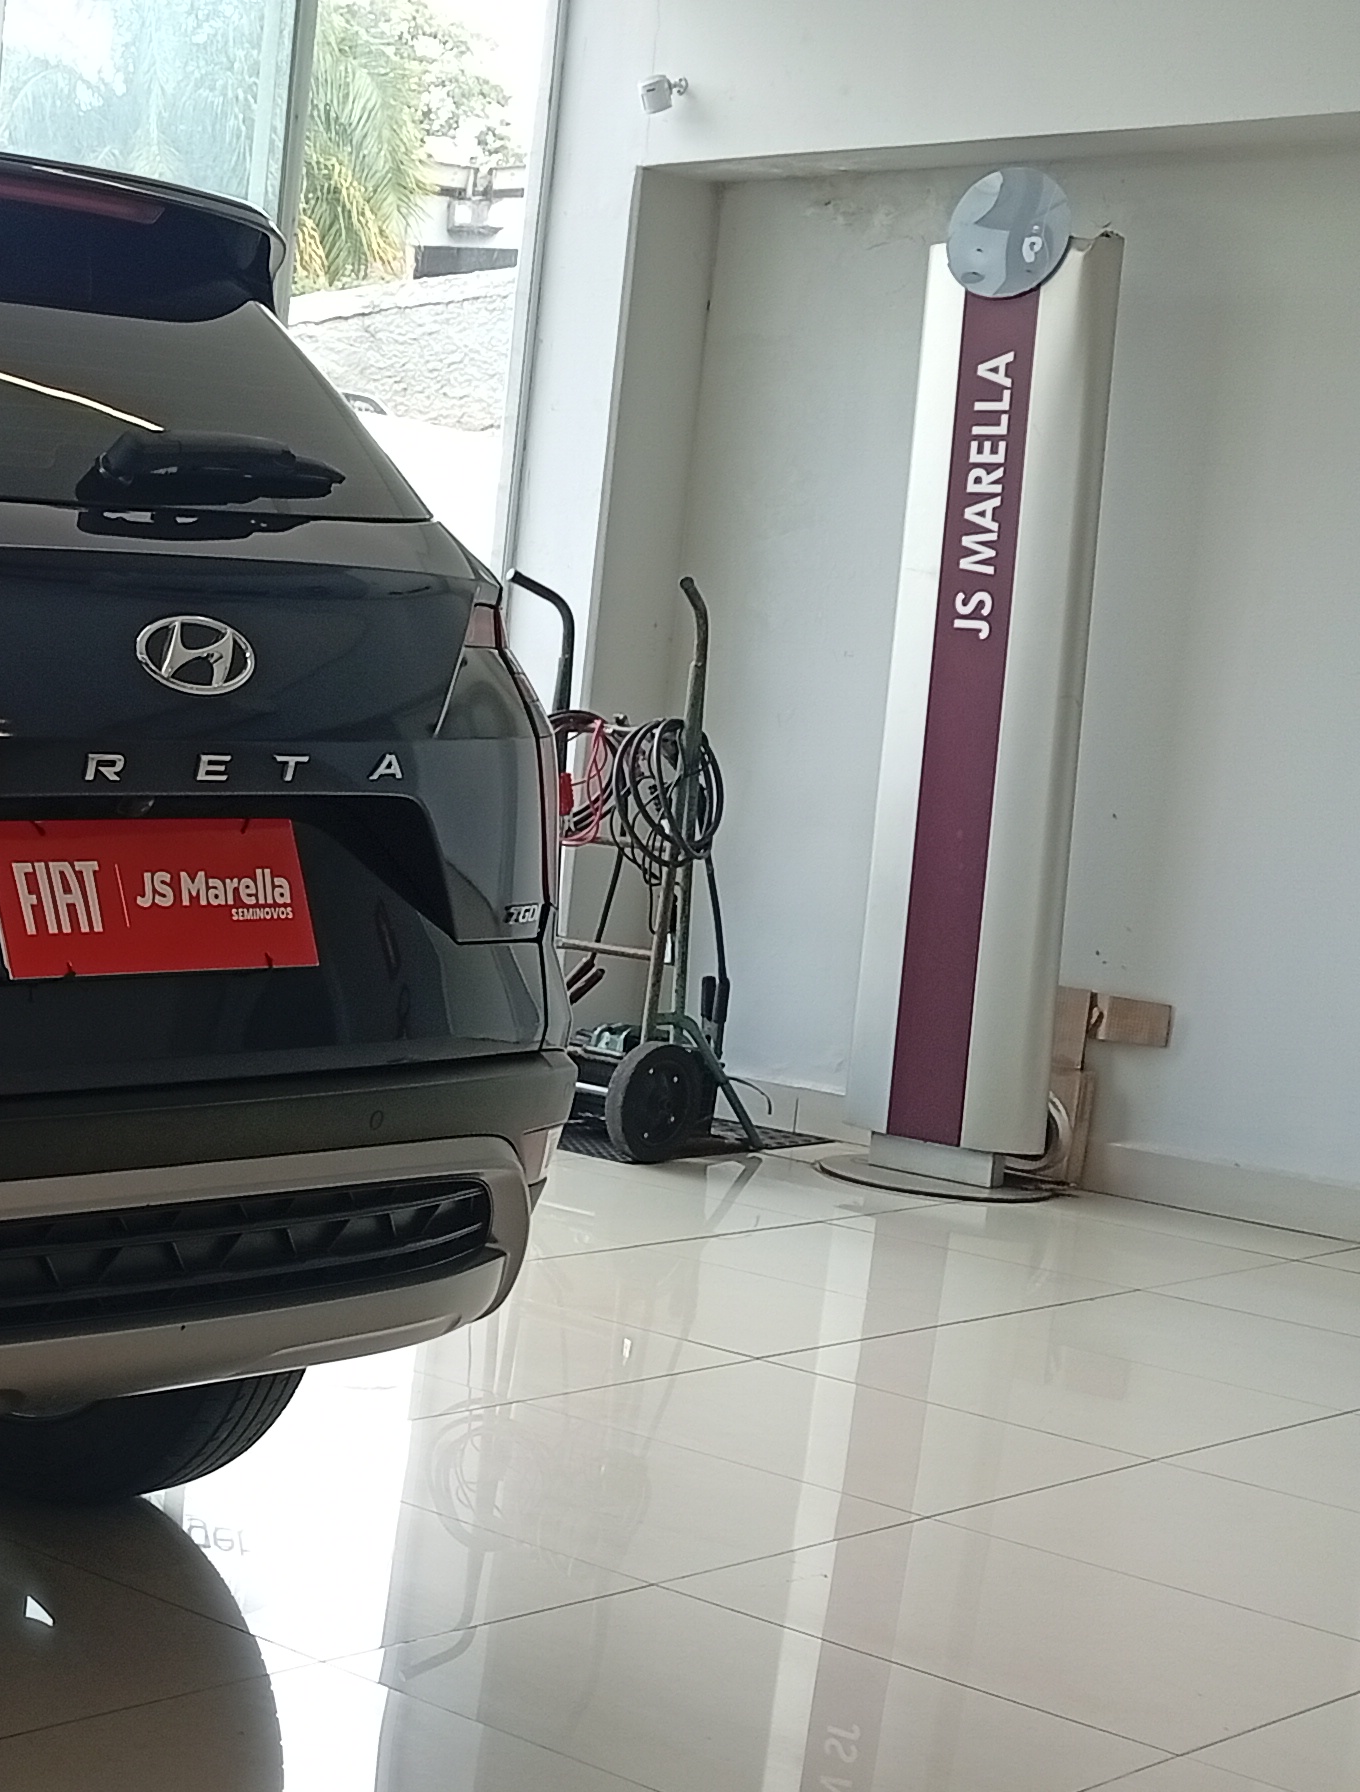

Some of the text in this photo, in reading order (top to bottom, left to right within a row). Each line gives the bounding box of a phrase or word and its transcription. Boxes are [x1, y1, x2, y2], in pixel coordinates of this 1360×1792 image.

[953, 351, 1015, 640] JS MARELLA
[11, 860, 104, 936] FIAT
[135, 867, 292, 909] JS Marella
[230, 906, 294, 921] SEMINOVOS
